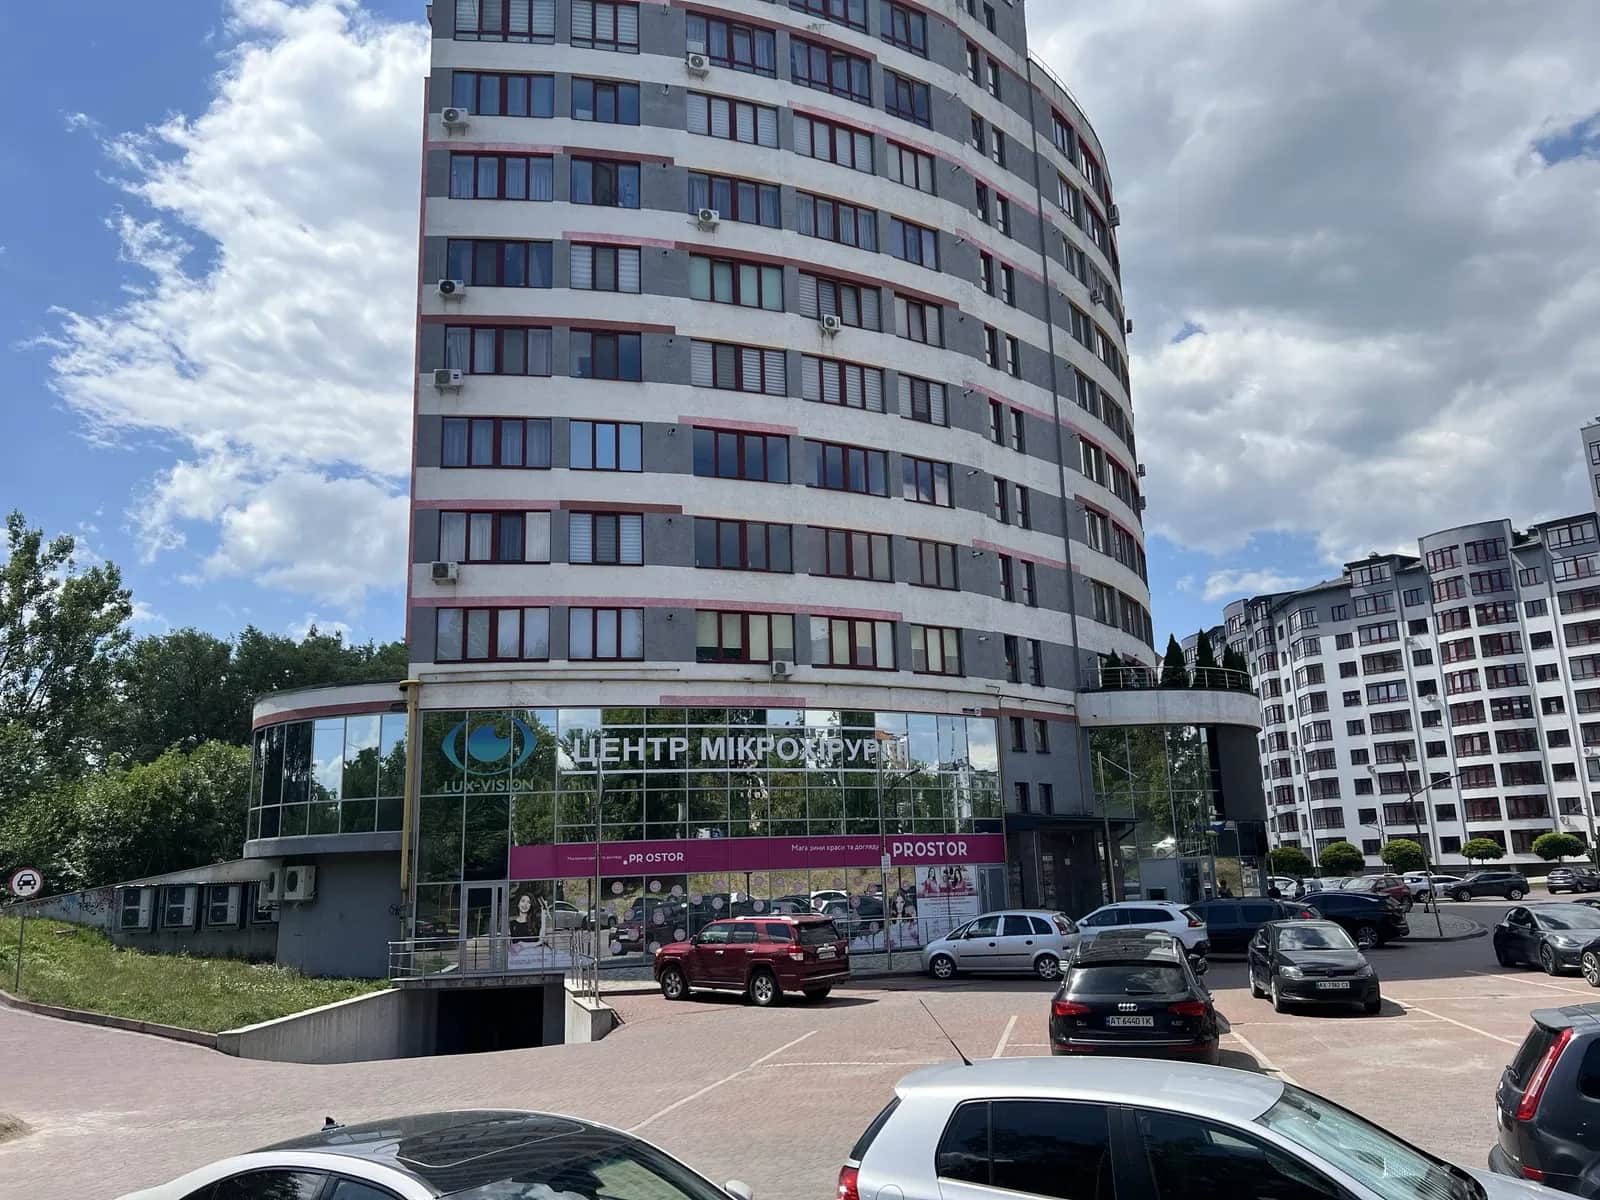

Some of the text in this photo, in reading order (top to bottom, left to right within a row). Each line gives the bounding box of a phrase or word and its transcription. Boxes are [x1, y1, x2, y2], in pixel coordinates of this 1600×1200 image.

[574, 737, 689, 767] ЦЕНТР
[444, 778, 534, 793] LUX-VISION
[892, 841, 968, 857] PROSTOR
